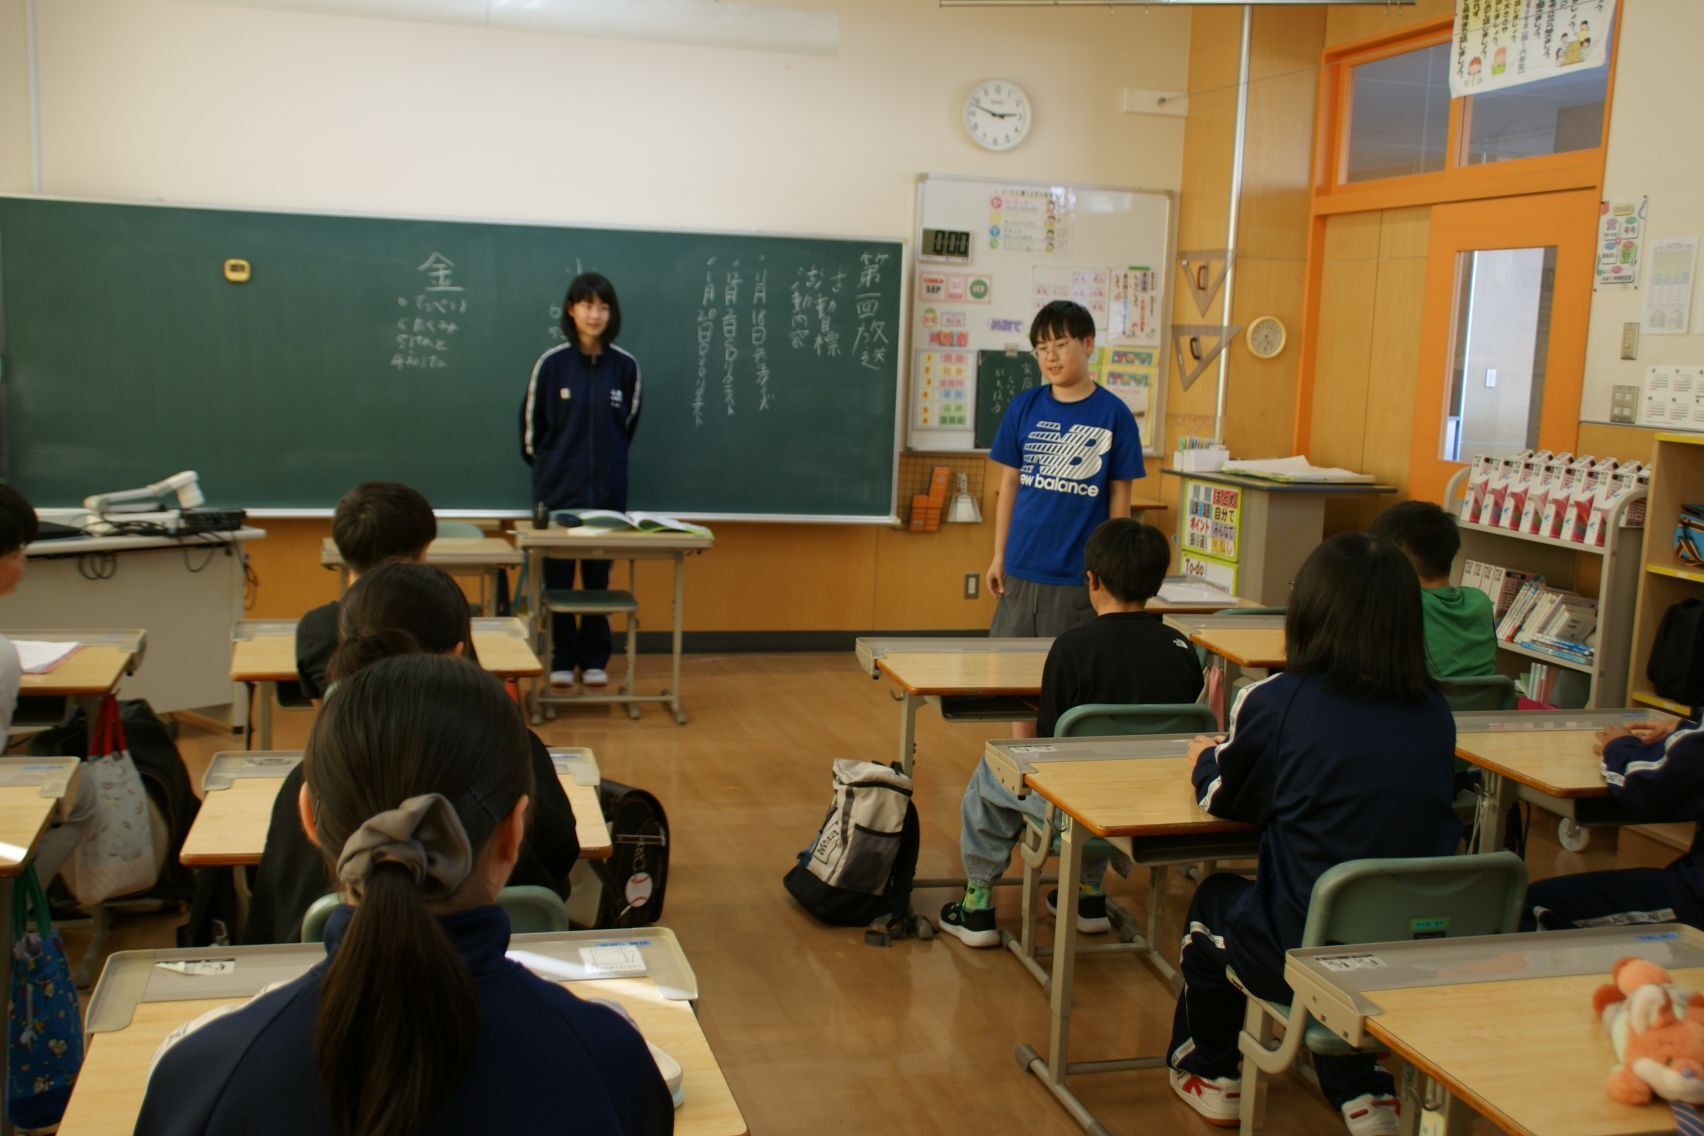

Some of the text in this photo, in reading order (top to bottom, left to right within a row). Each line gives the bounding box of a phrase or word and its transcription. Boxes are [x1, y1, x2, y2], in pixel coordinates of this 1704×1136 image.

[416, 251, 466, 292] 金
[1034, 473, 1099, 497] balance
[1216, 491, 1235, 507] まとめ
[1214, 507, 1235, 522] 自分で
[1190, 516, 1209, 532] ポイント
